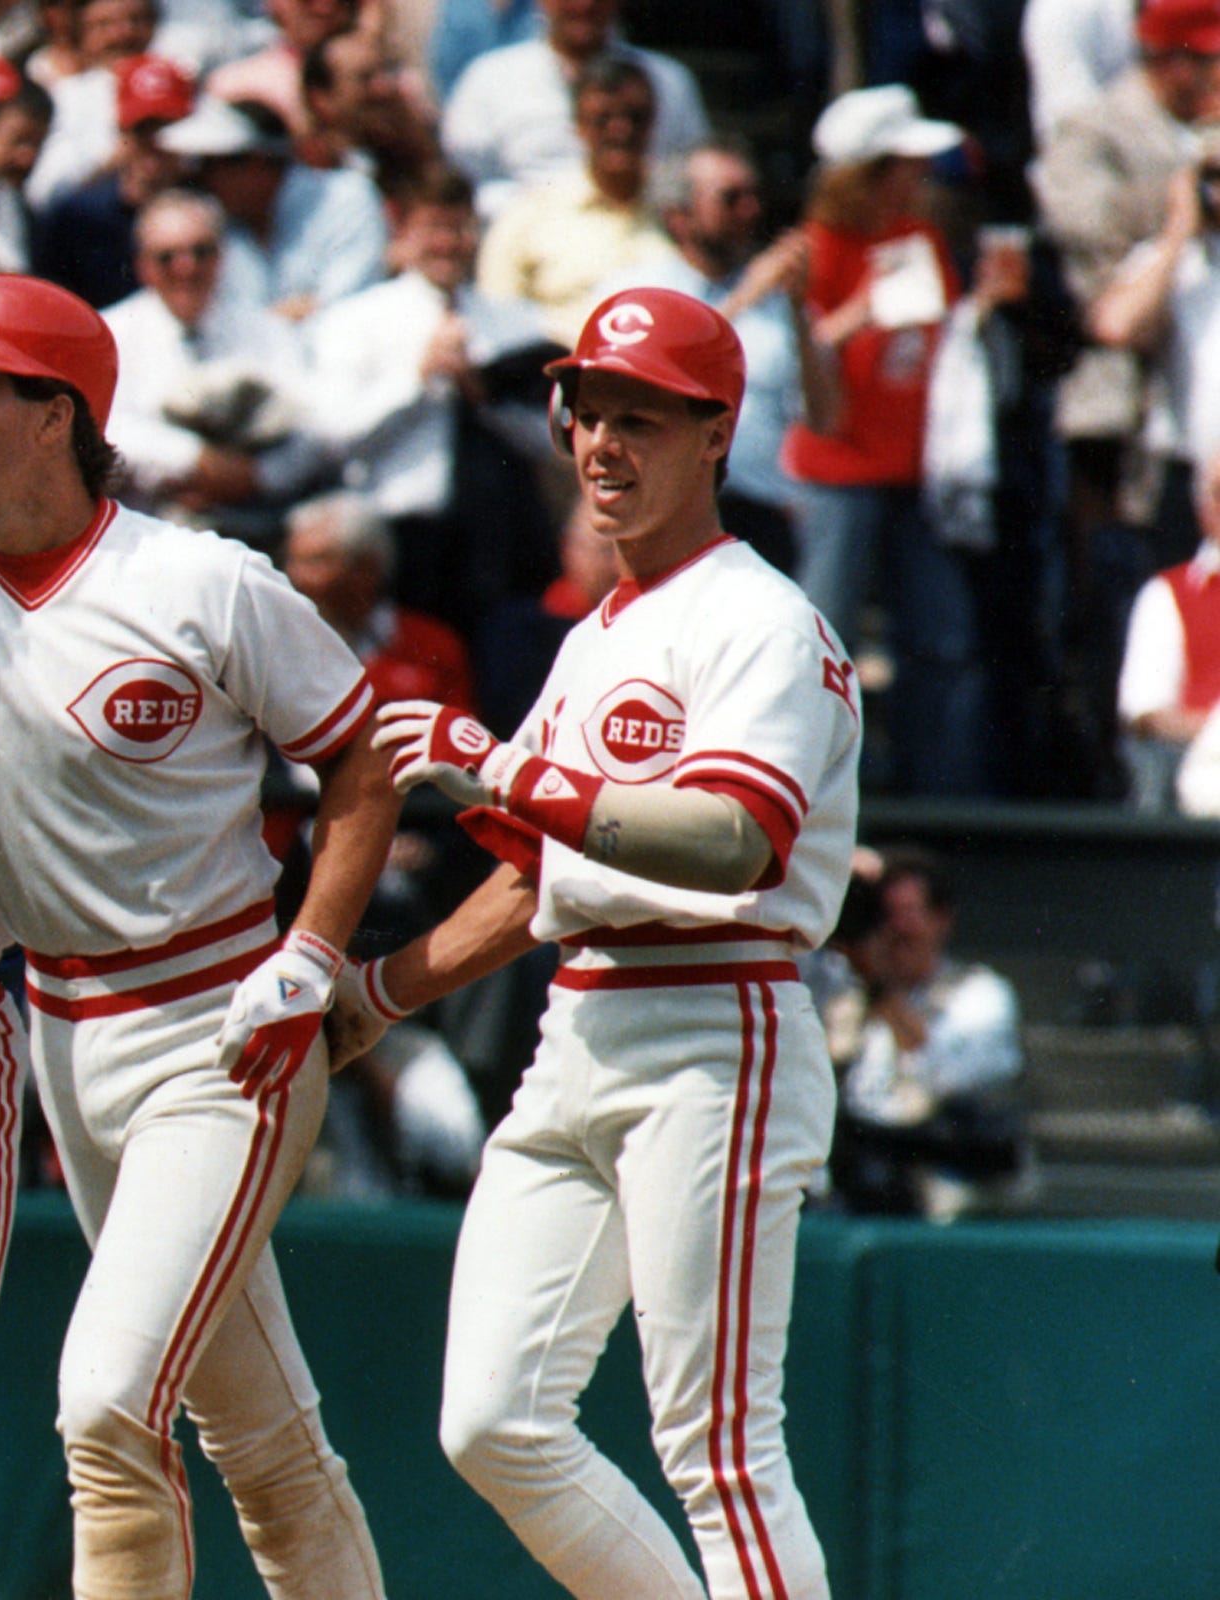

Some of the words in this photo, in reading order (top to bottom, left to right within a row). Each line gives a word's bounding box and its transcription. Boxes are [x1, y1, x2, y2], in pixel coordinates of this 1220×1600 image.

[598, 303, 654, 346] C
[113, 698, 196, 724] REDS
[606, 715, 686, 750] REDS
